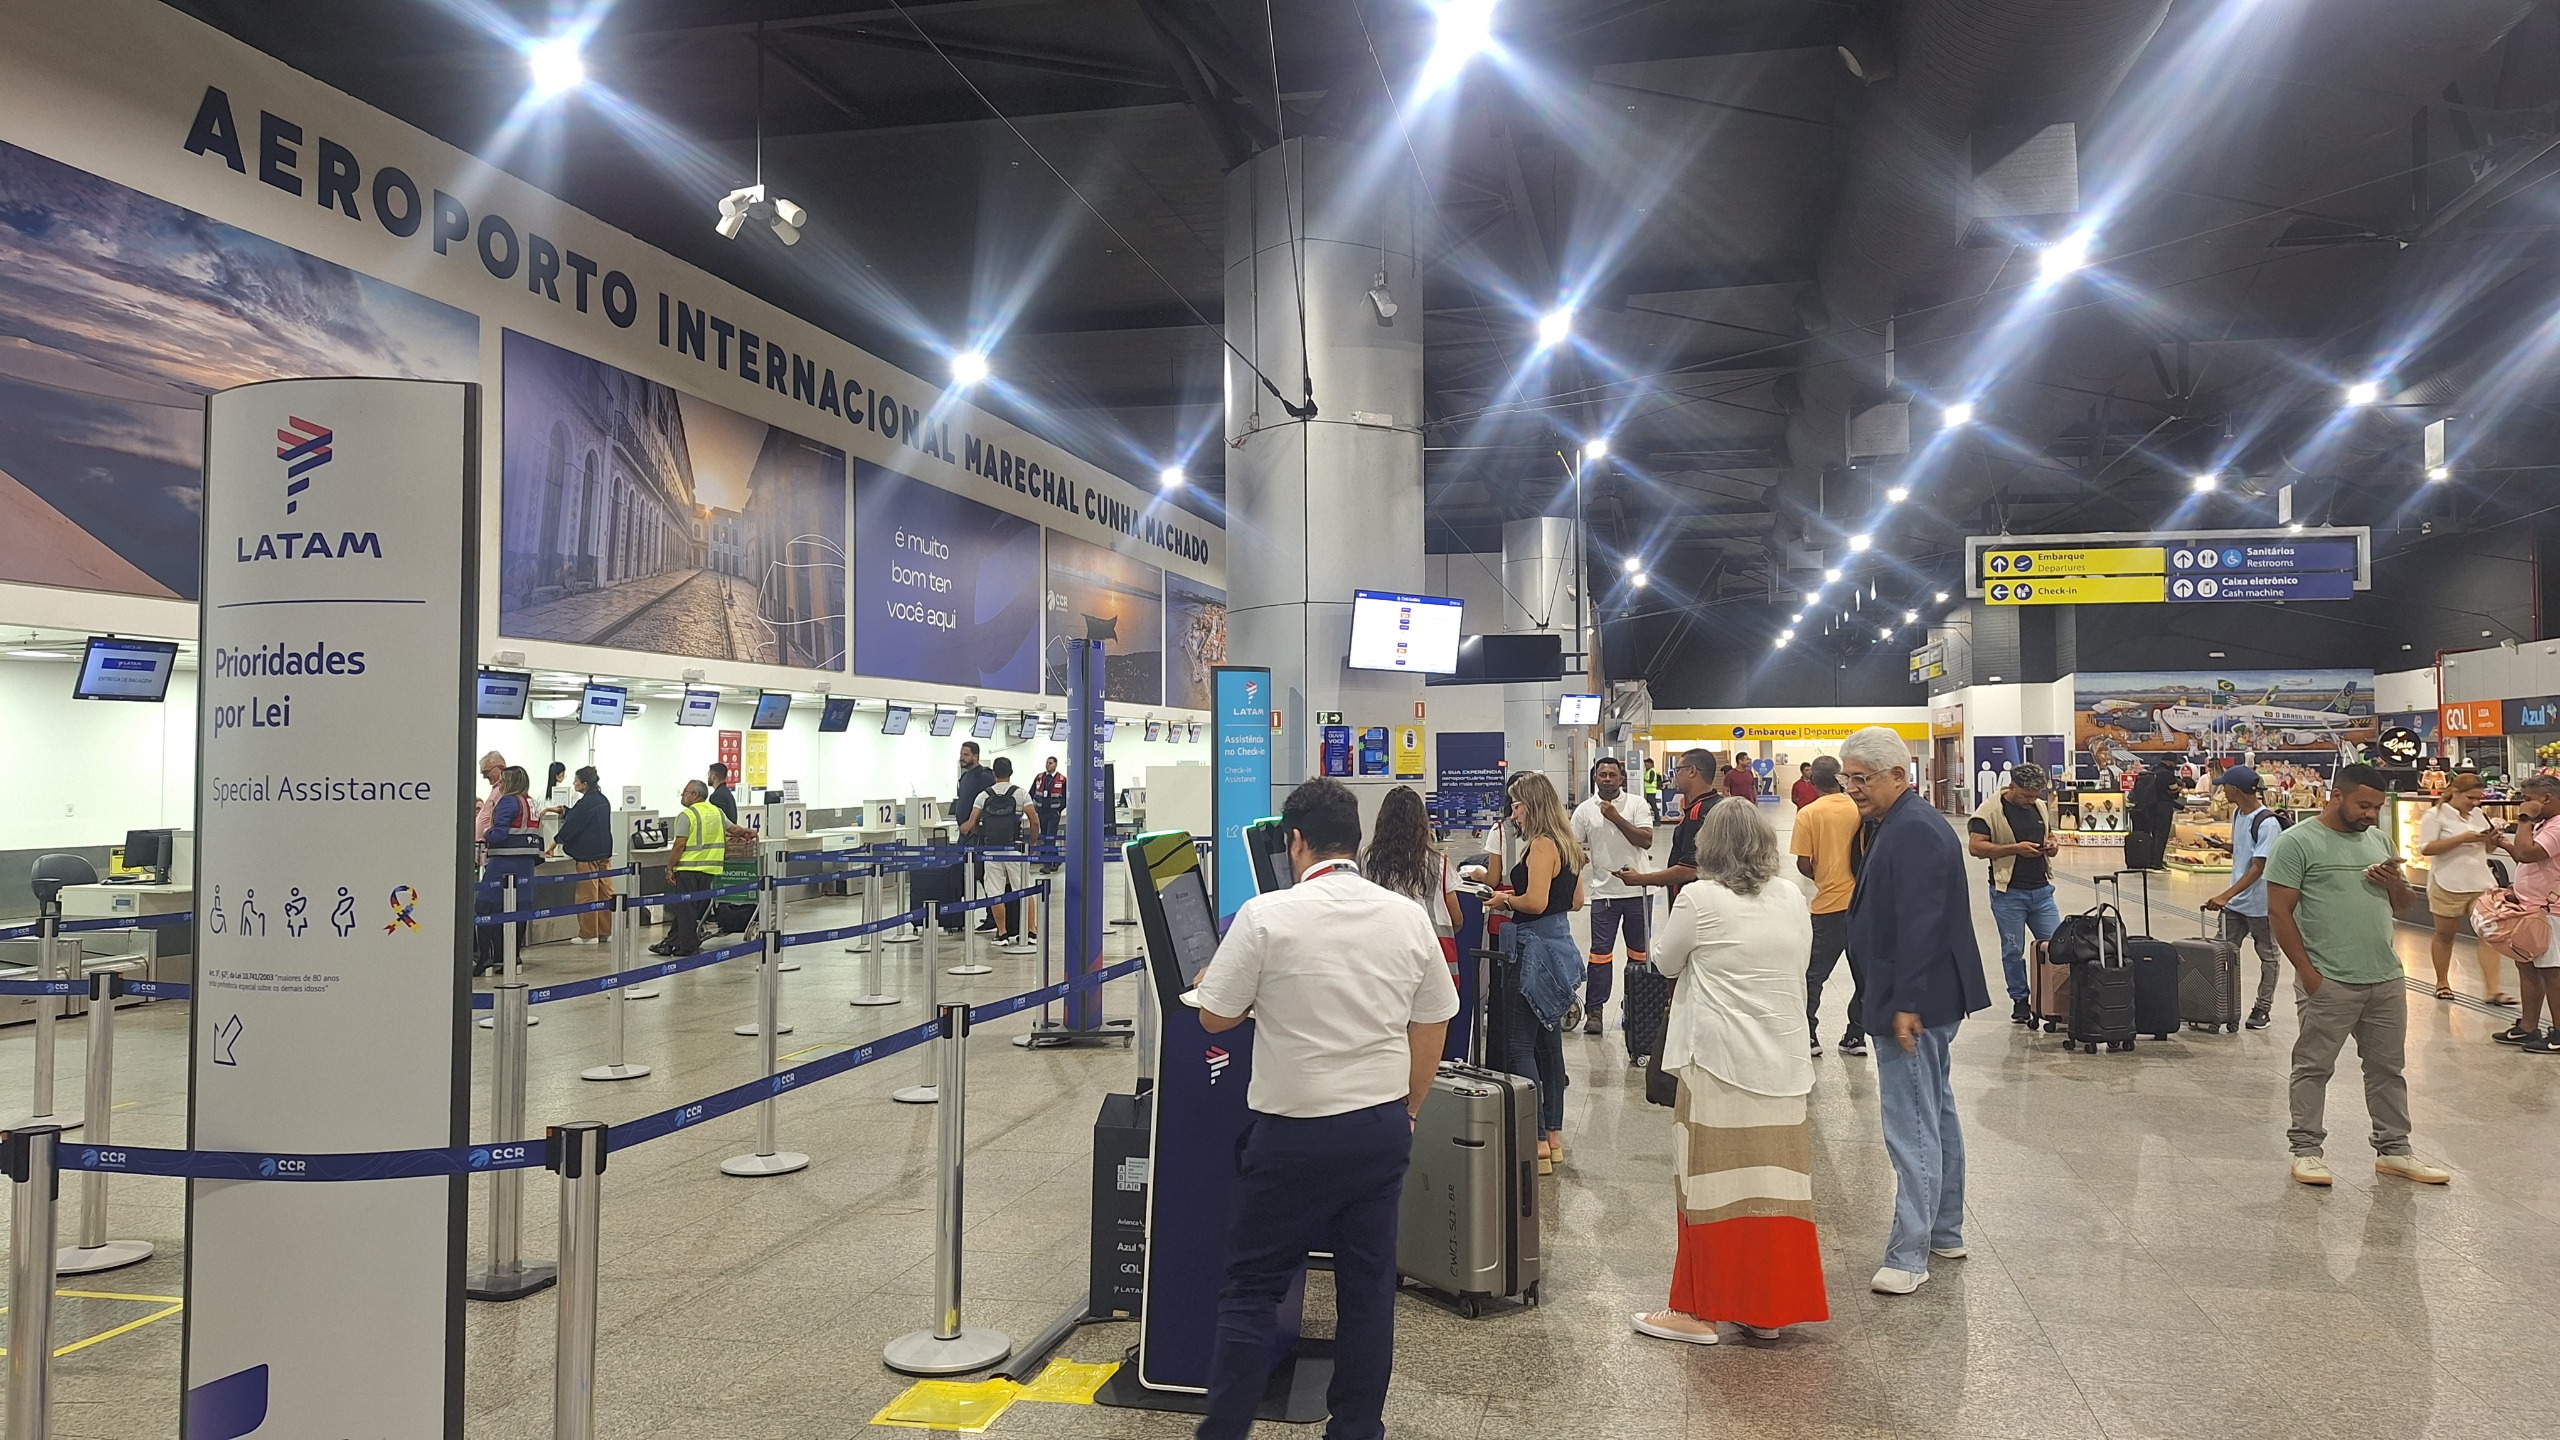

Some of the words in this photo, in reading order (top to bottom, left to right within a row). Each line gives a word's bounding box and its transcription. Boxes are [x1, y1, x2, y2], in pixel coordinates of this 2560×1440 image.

[183, 85, 638, 329] AEROPORTO
[658, 291, 956, 465] INTERNACIONAL
[965, 433, 1079, 515] MARECHAL
[1085, 488, 1141, 540] CUNHA
[1145, 514, 1209, 565] MACHADO
[237, 532, 382, 563] LATAM
[895, 526, 905, 548] é
[908, 533, 949, 560] muito
[2246, 546, 2295, 555] Sanitários
[2038, 552, 2085, 563] Embarque
[2246, 558, 2294, 568] Restrooms
[2038, 563, 2086, 574] Departures
[891, 559, 927, 589] bom
[929, 571, 952, 594] ter
[2221, 576, 2249, 586] Caixa
[2250, 575, 2299, 587] eletrônico
[2038, 586, 2077, 596] Check-in
[2222, 587, 2245, 598] Cash
[2246, 587, 2285, 597] machine
[1055, 595, 1068, 607] CCR
[887, 600, 924, 623] você
[927, 608, 957, 633] aqui
[216, 641, 366, 678] Prioridades
[214, 703, 246, 739] por
[252, 695, 290, 728] Lei
[1233, 708, 1264, 716] LATAM
[2521, 704, 2545, 726] Azul
[2446, 708, 2468, 731] GOL
[1748, 727, 1797, 738] Embarque
[1803, 727, 1854, 738] Departures
[1224, 735, 1264, 744] Assistência
[1224, 748, 1235, 756] no
[1237, 747, 1265, 756] Check-in
[1224, 766, 1252, 774] Check-in
[212, 774, 270, 809] Special
[277, 776, 431, 801] Assistance
[879, 805, 891, 823] 12
[922, 802, 931, 820] 11
[745, 813, 761, 832] 14
[788, 810, 802, 830] 13
[667, 963, 677, 972] CCR
[303, 974, 311, 982] de
[312, 974, 322, 982] 80
[323, 974, 340, 982] anos
[606, 977, 618, 986] CCR
[55, 983, 69, 991] CCR
[141, 983, 156, 992] CCR
[281, 984, 303, 993] demais
[539, 990, 551, 999] CCR
[927, 1022, 939, 1033] CCR
[860, 1046, 873, 1058] CCR
[781, 1072, 795, 1086] CCR
[686, 1104, 702, 1119] CCR
[100, 1151, 127, 1164] CCR
[492, 1146, 525, 1160] CCR
[277, 1159, 306, 1171] CCR
[1118, 1218, 1139, 1226] Avianca
[1117, 1243, 1137, 1252] Azul
[1120, 1263, 1142, 1275] GOL
[1120, 1286, 1143, 1294] LATA
